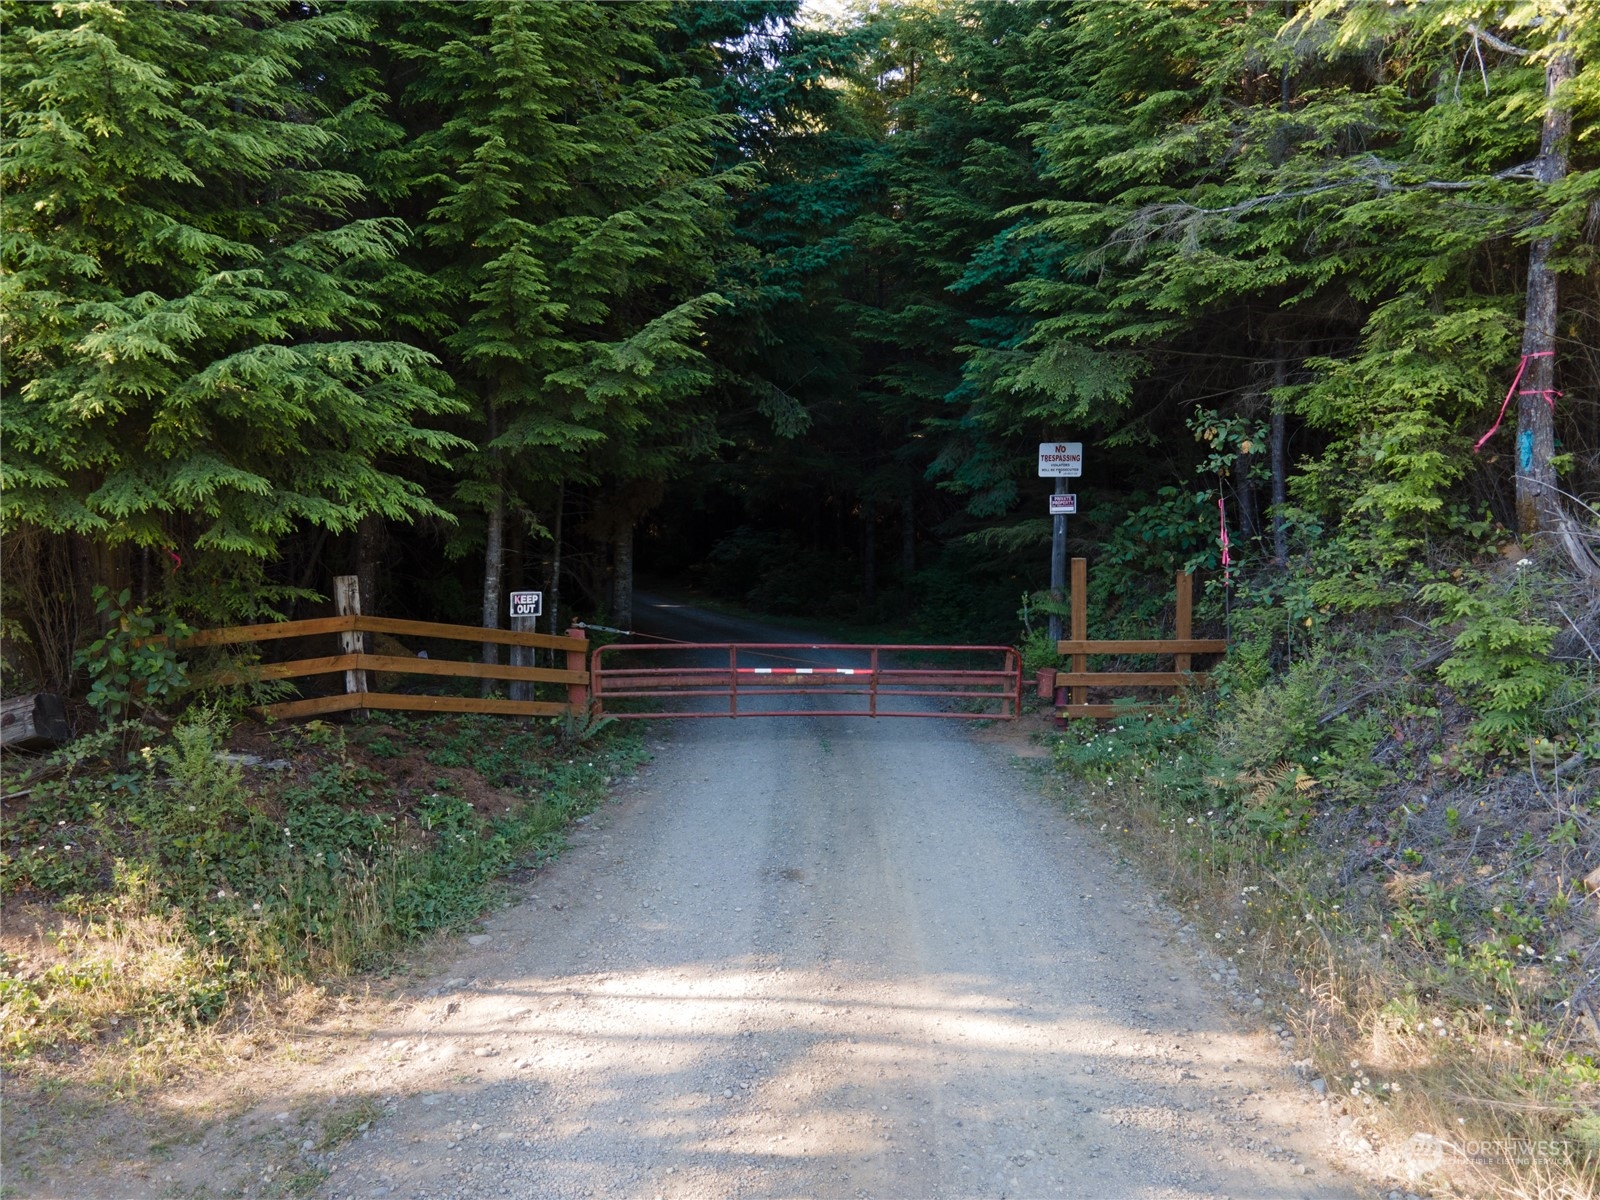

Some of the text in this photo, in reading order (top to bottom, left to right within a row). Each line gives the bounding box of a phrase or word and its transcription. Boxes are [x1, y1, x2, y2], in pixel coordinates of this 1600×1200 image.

[1055, 445, 1066, 453] NO
[514, 595, 538, 604] KEEP
[517, 604, 536, 613] OUT
